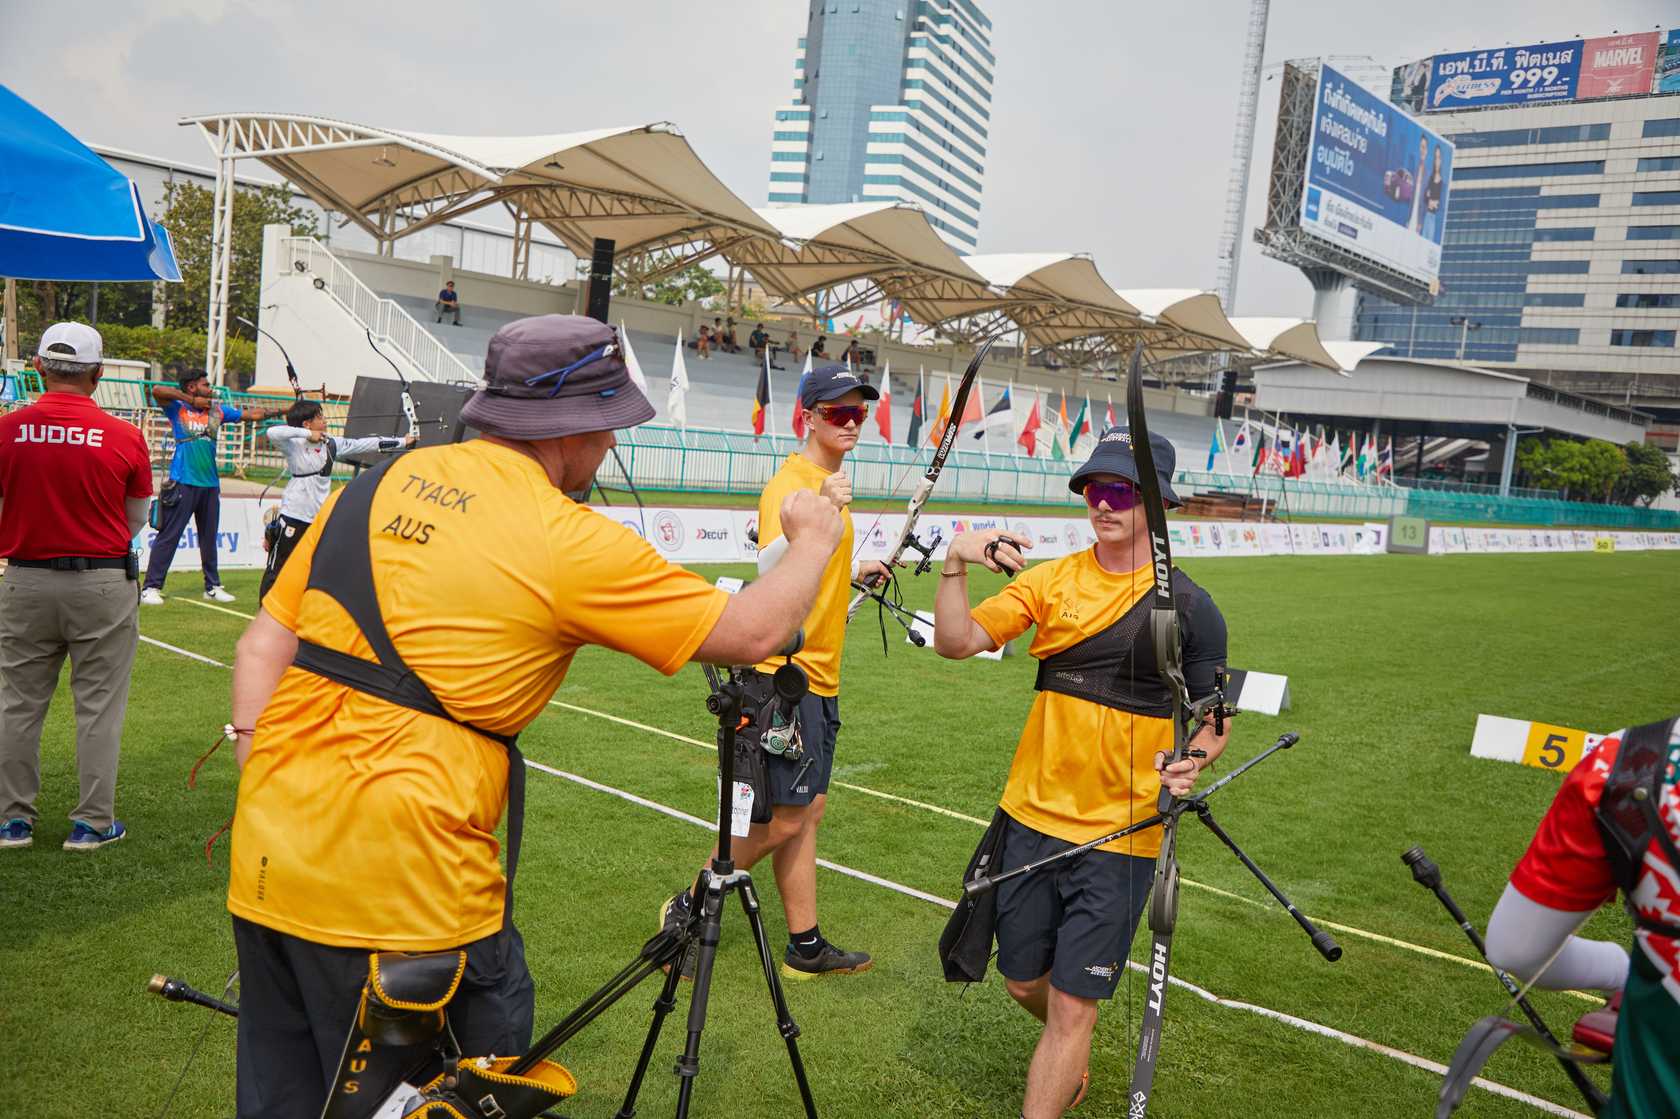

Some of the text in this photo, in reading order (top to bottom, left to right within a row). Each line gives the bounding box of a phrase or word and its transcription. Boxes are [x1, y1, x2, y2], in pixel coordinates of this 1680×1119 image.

[1515, 49, 1574, 68] ฟิตเนส
[1594, 47, 1642, 68] MARVEL
[15, 424, 104, 447] JUDGE
[401, 474, 477, 514] TYACK
[382, 514, 436, 545] AUS
[1401, 525, 1416, 540] 13
[1152, 531, 1170, 599] HOYT
[1539, 733, 1568, 768] 5
[1149, 943, 1167, 1016] HOYT
[344, 1038, 372, 1094] AUS
